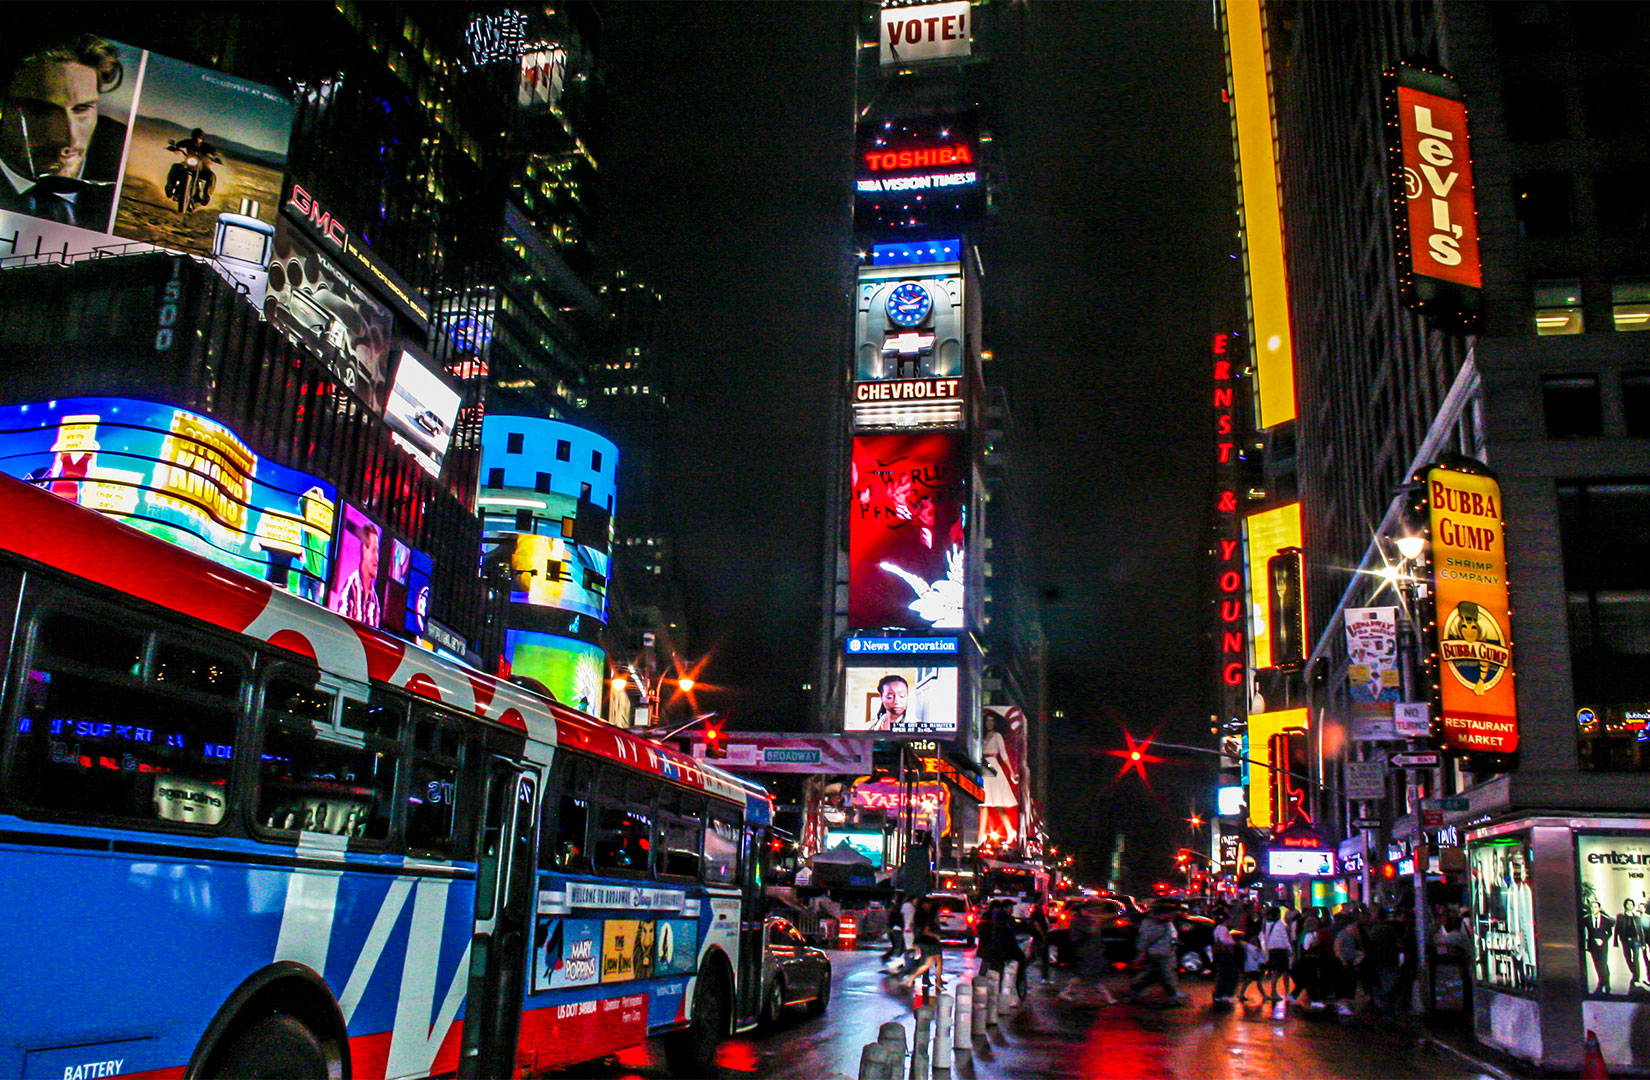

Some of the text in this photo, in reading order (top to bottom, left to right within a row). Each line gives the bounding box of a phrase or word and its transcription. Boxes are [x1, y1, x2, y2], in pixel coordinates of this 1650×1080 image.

[887, 14, 965, 46] VOTE!
[865, 144, 972, 171] TOSHIBA
[883, 176, 931, 191] VISION
[292, 184, 346, 249] GMC
[857, 380, 958, 400] CHEVROLET
[1432, 480, 1498, 519] BUBBA
[1214, 334, 1244, 686] ERNST & YOUNG
[1440, 517, 1495, 552] GUMP
[1446, 557, 1493, 571] SHRIMP
[1441, 568, 1499, 584] COMPANY
[862, 640, 956, 653] News Corporation
[1443, 642, 1508, 667] BUBBA GUMP
[1403, 707, 1419, 718] NO
[1396, 720, 1429, 731] TURNS
[1445, 717, 1515, 733] RESTAURANT
[1458, 734, 1505, 747] MARKET
[767, 751, 817, 762] BROADWAY
[571, 940, 593, 959] MARY
[564, 957, 596, 981] POPPINS
[557, 1005, 565, 1019] US
[565, 1003, 578, 1018] DOT
[64, 1059, 124, 1080] BATTERY
